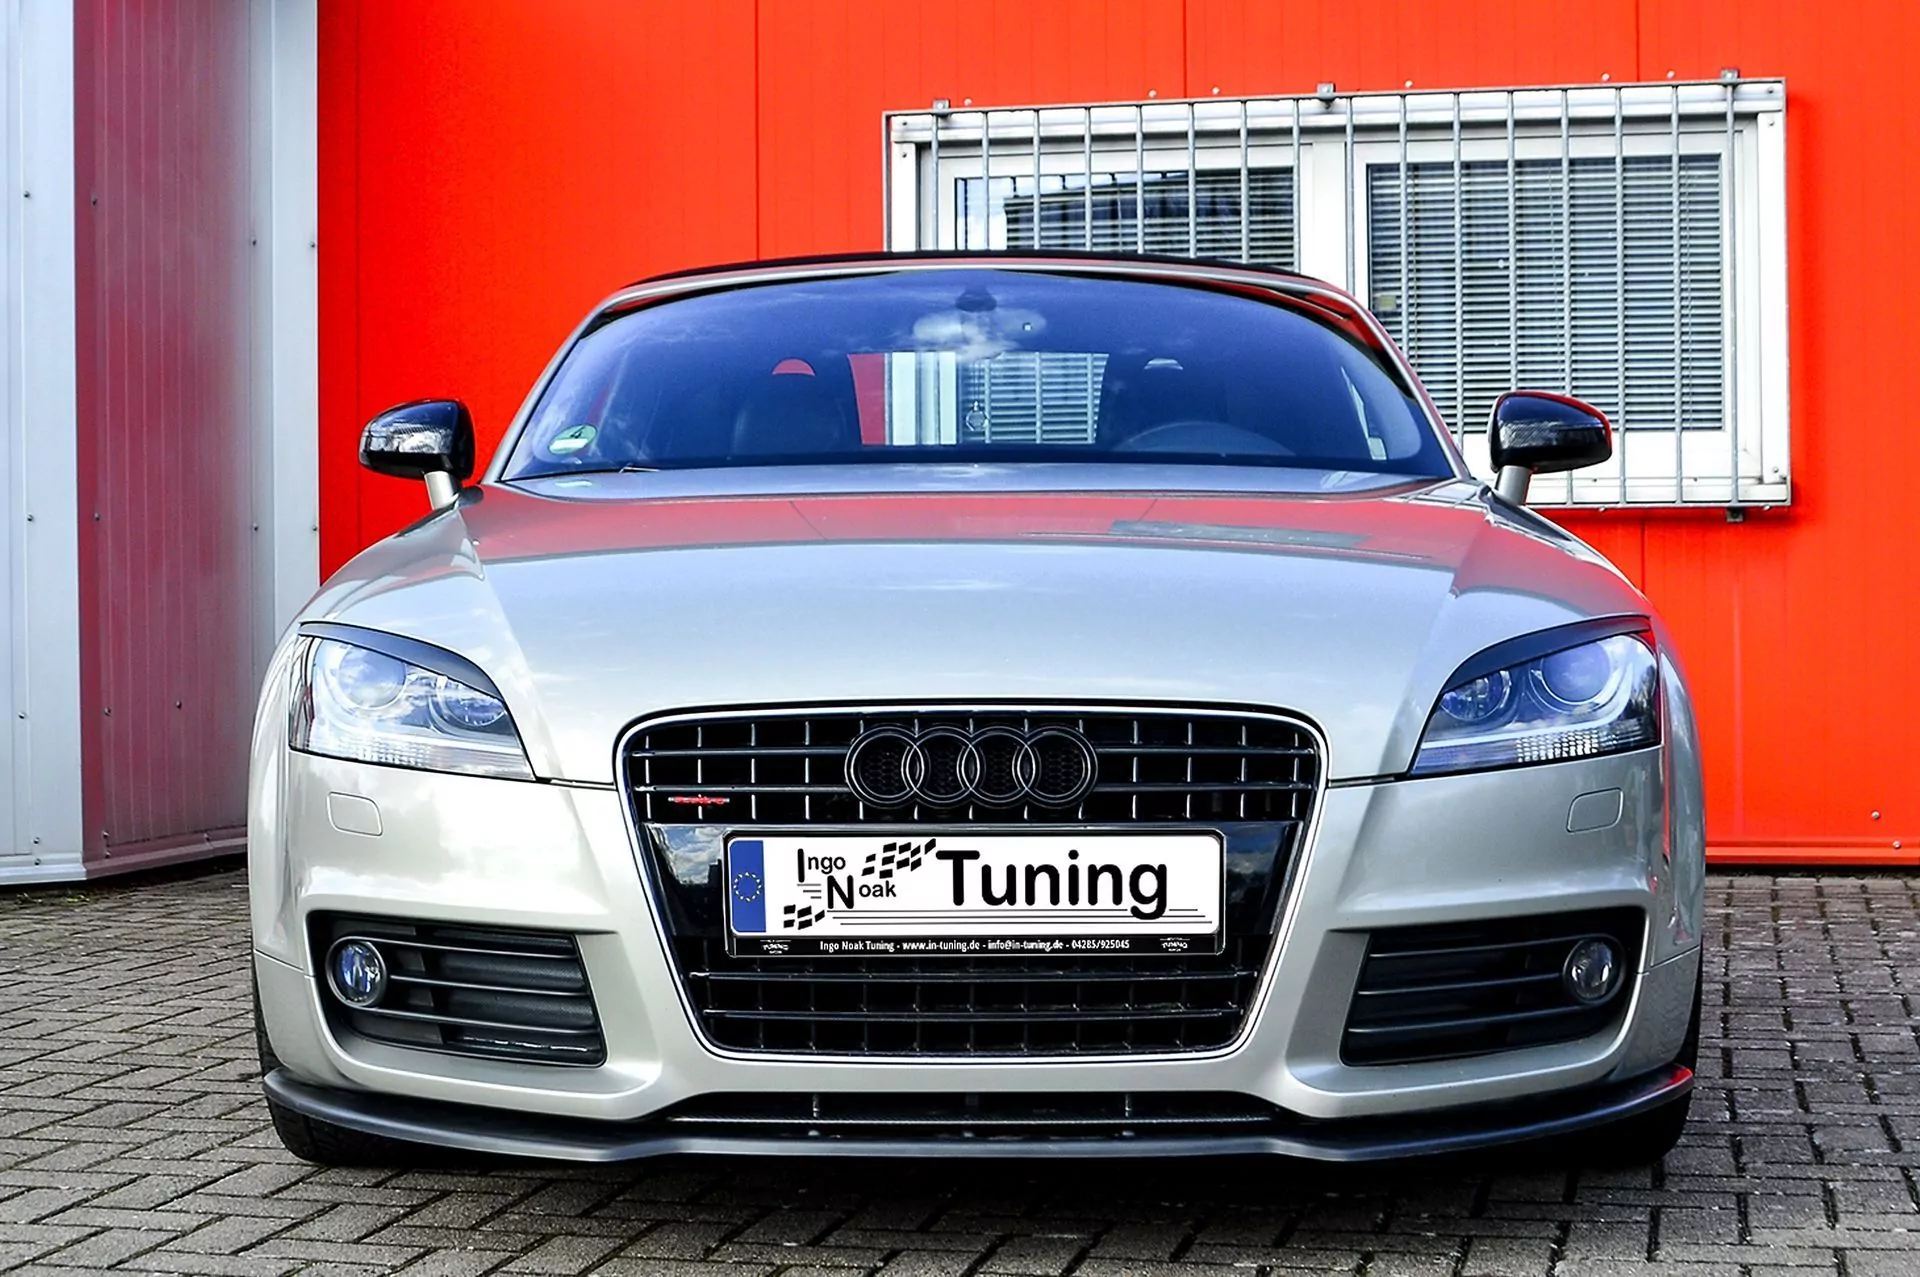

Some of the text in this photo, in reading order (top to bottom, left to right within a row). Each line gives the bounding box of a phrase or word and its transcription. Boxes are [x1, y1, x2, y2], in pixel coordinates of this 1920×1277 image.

[797, 848, 846, 883] Ingo
[827, 875, 897, 909] Noak
[935, 849, 1168, 920] Tuning
[820, 940, 840, 953] Ingo
[841, 940, 865, 951] Noak
[865, 940, 895, 952] Tuning
[902, 939, 980, 953] www.in-tuning.de
[987, 939, 1064, 952] info@in-tuning.de
